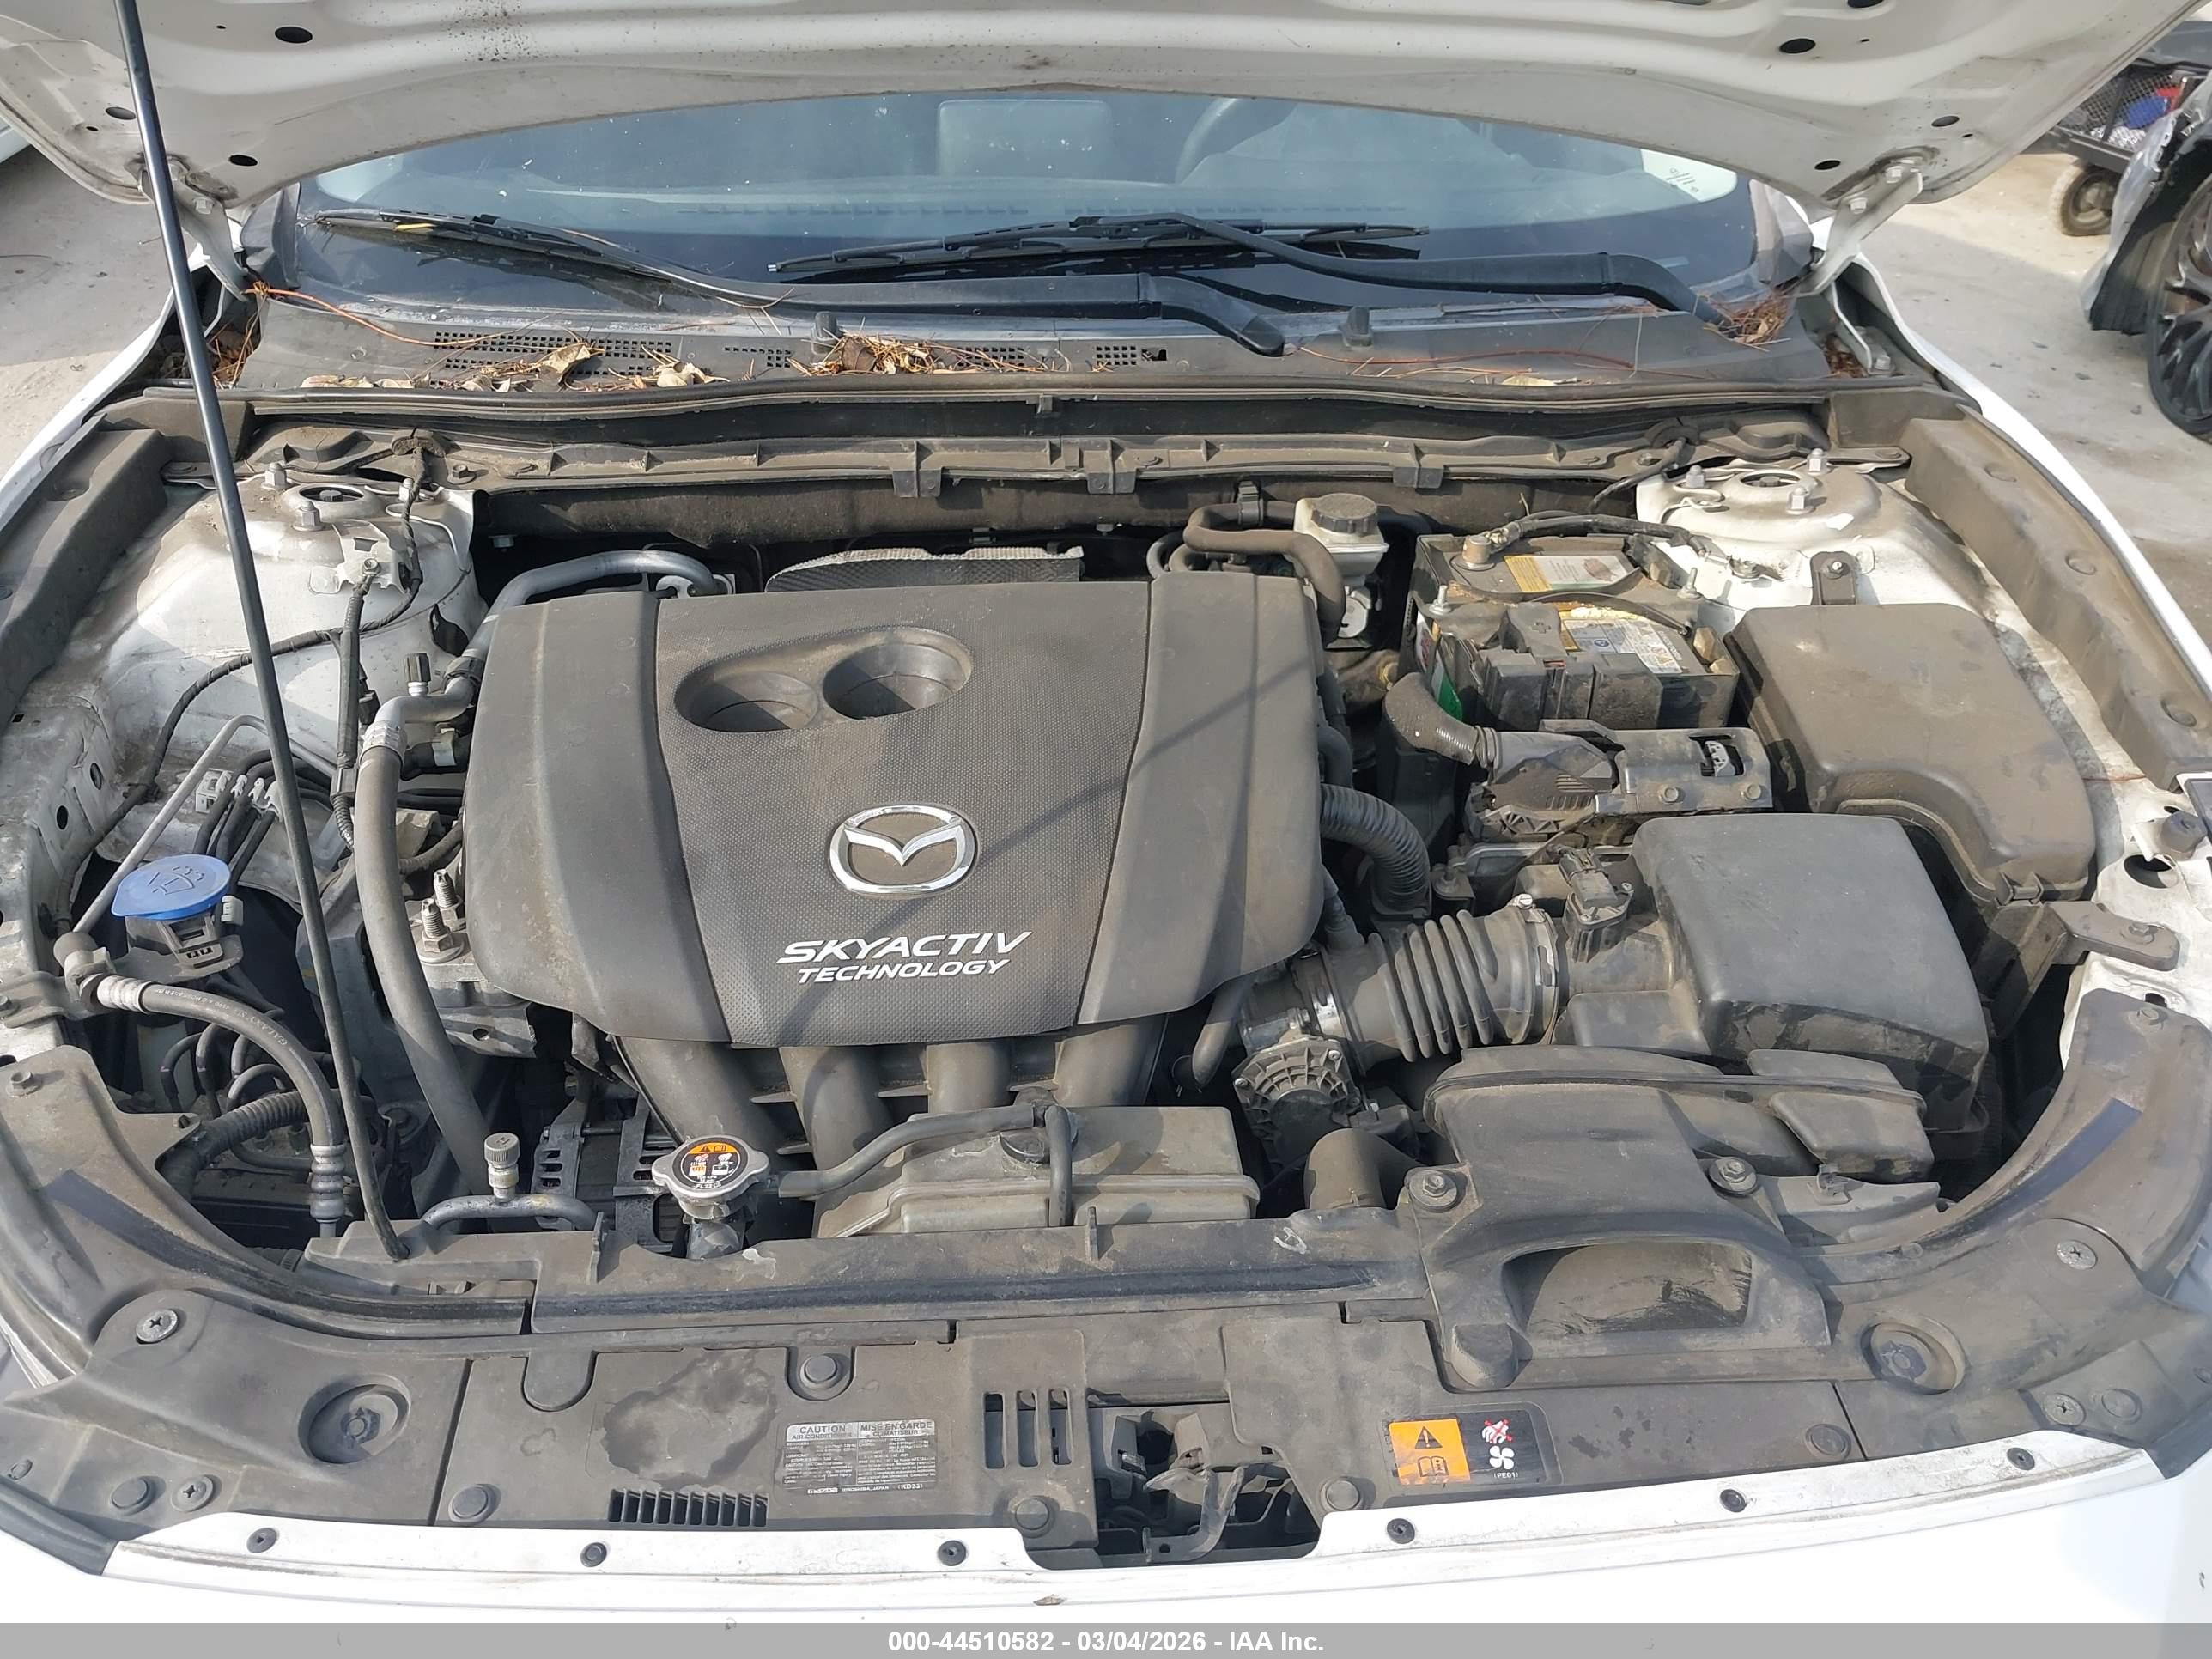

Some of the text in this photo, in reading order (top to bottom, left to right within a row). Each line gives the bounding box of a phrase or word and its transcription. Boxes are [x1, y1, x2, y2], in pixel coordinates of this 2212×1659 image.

[776, 931, 1032, 964] SKYACTIV
[798, 958, 1010, 984] TECHNOLOGY
[799, 1425, 846, 1434] CAUTION
[900, 1421, 933, 1430] GARDE
